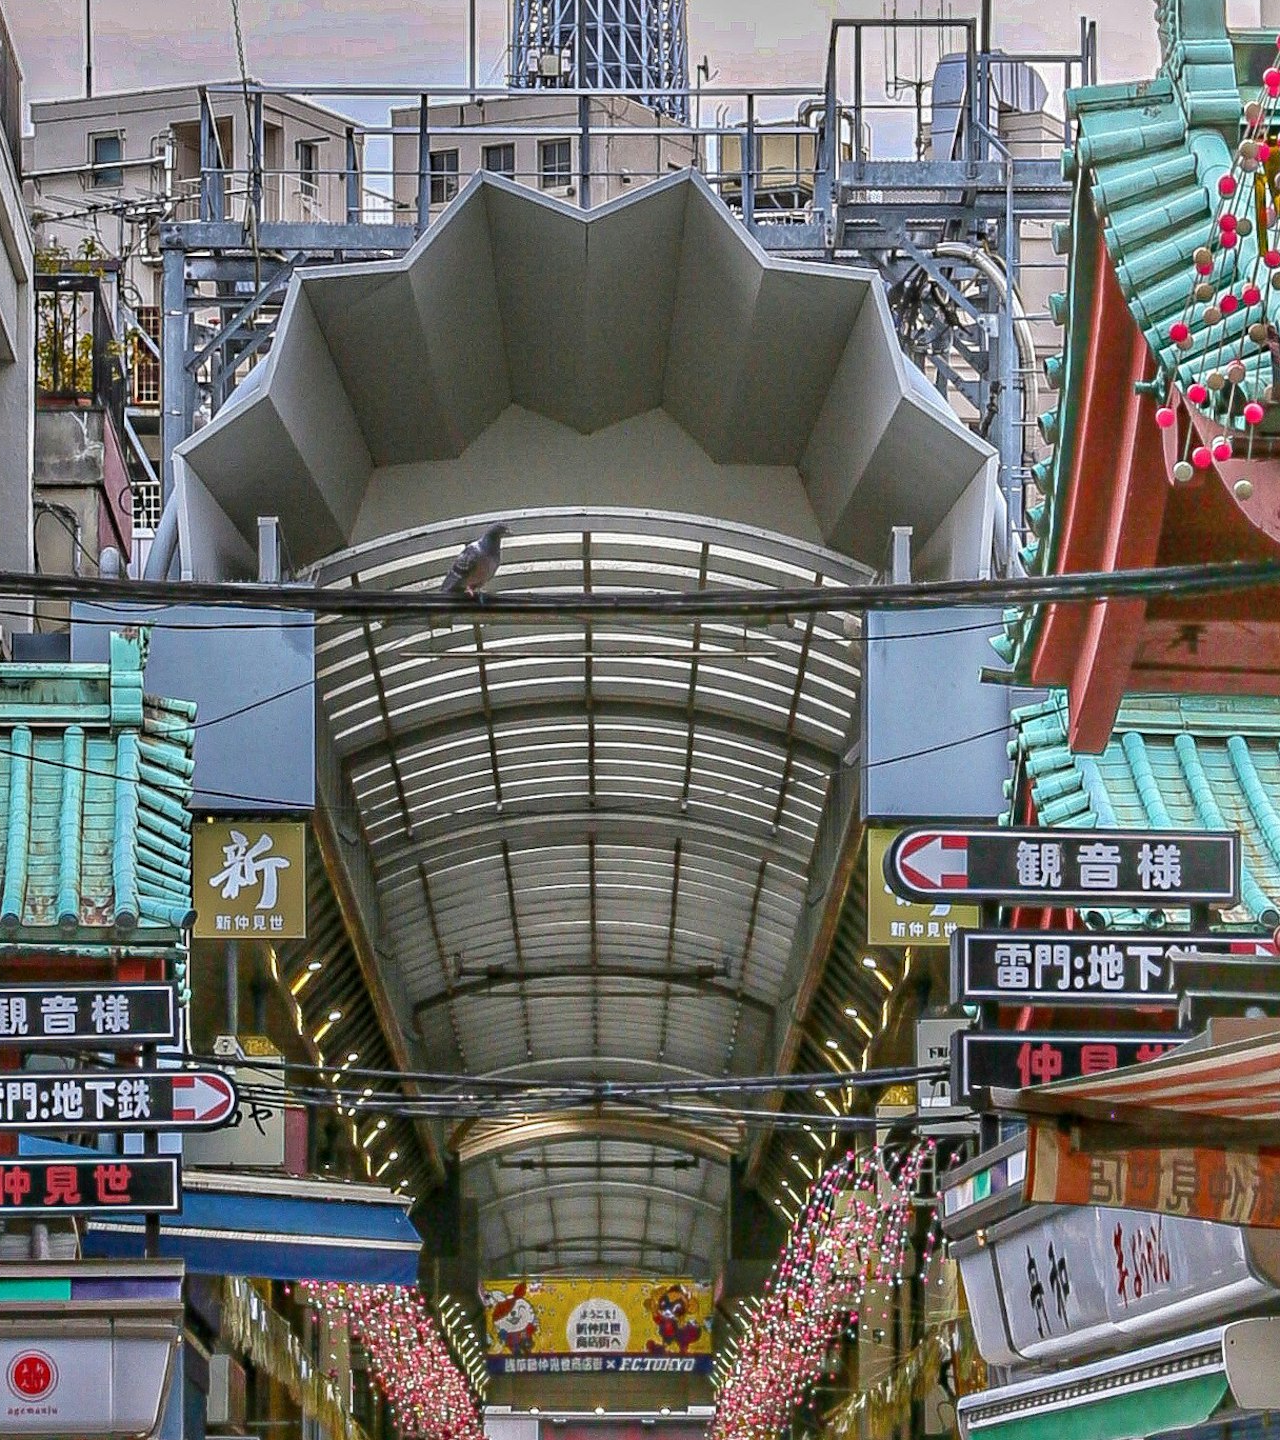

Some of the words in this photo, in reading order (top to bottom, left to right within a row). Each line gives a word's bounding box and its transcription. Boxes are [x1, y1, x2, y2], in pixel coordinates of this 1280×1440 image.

[210, 828, 291, 911] 新
[1016, 841, 1183, 890] 観音様
[214, 914, 286, 933] 新仲見世
[1017, 1042, 1178, 1087] 仲見
